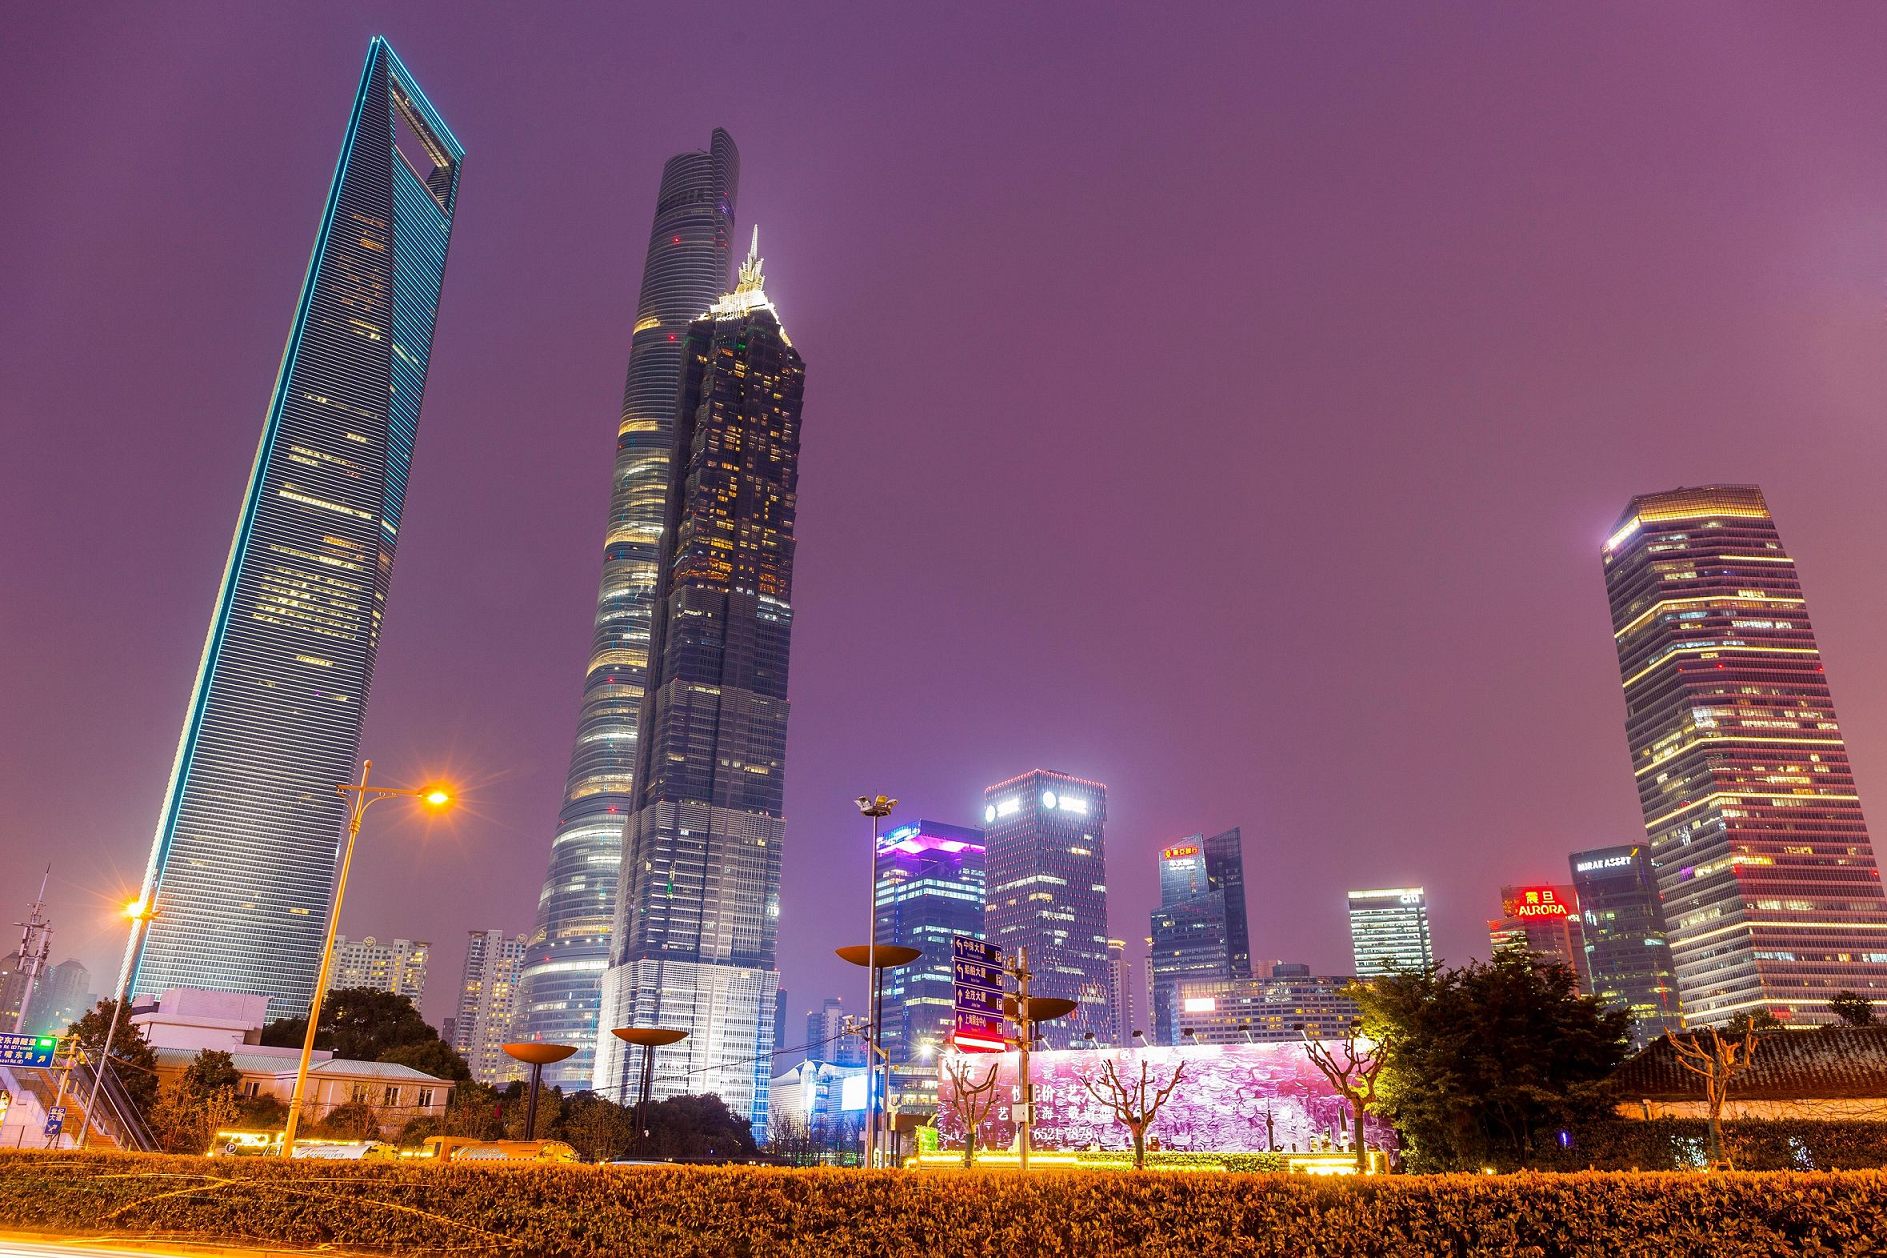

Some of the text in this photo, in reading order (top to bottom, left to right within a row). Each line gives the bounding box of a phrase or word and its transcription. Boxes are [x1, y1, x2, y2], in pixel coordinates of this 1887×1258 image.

[1577, 856, 1631, 872] MIRAE ASSET
[1526, 891, 1555, 904] 震旦
[1519, 904, 1567, 916] AURORA
[965, 989, 987, 1002] 金茂大厦
[1034, 1127, 1060, 1140] 6521
